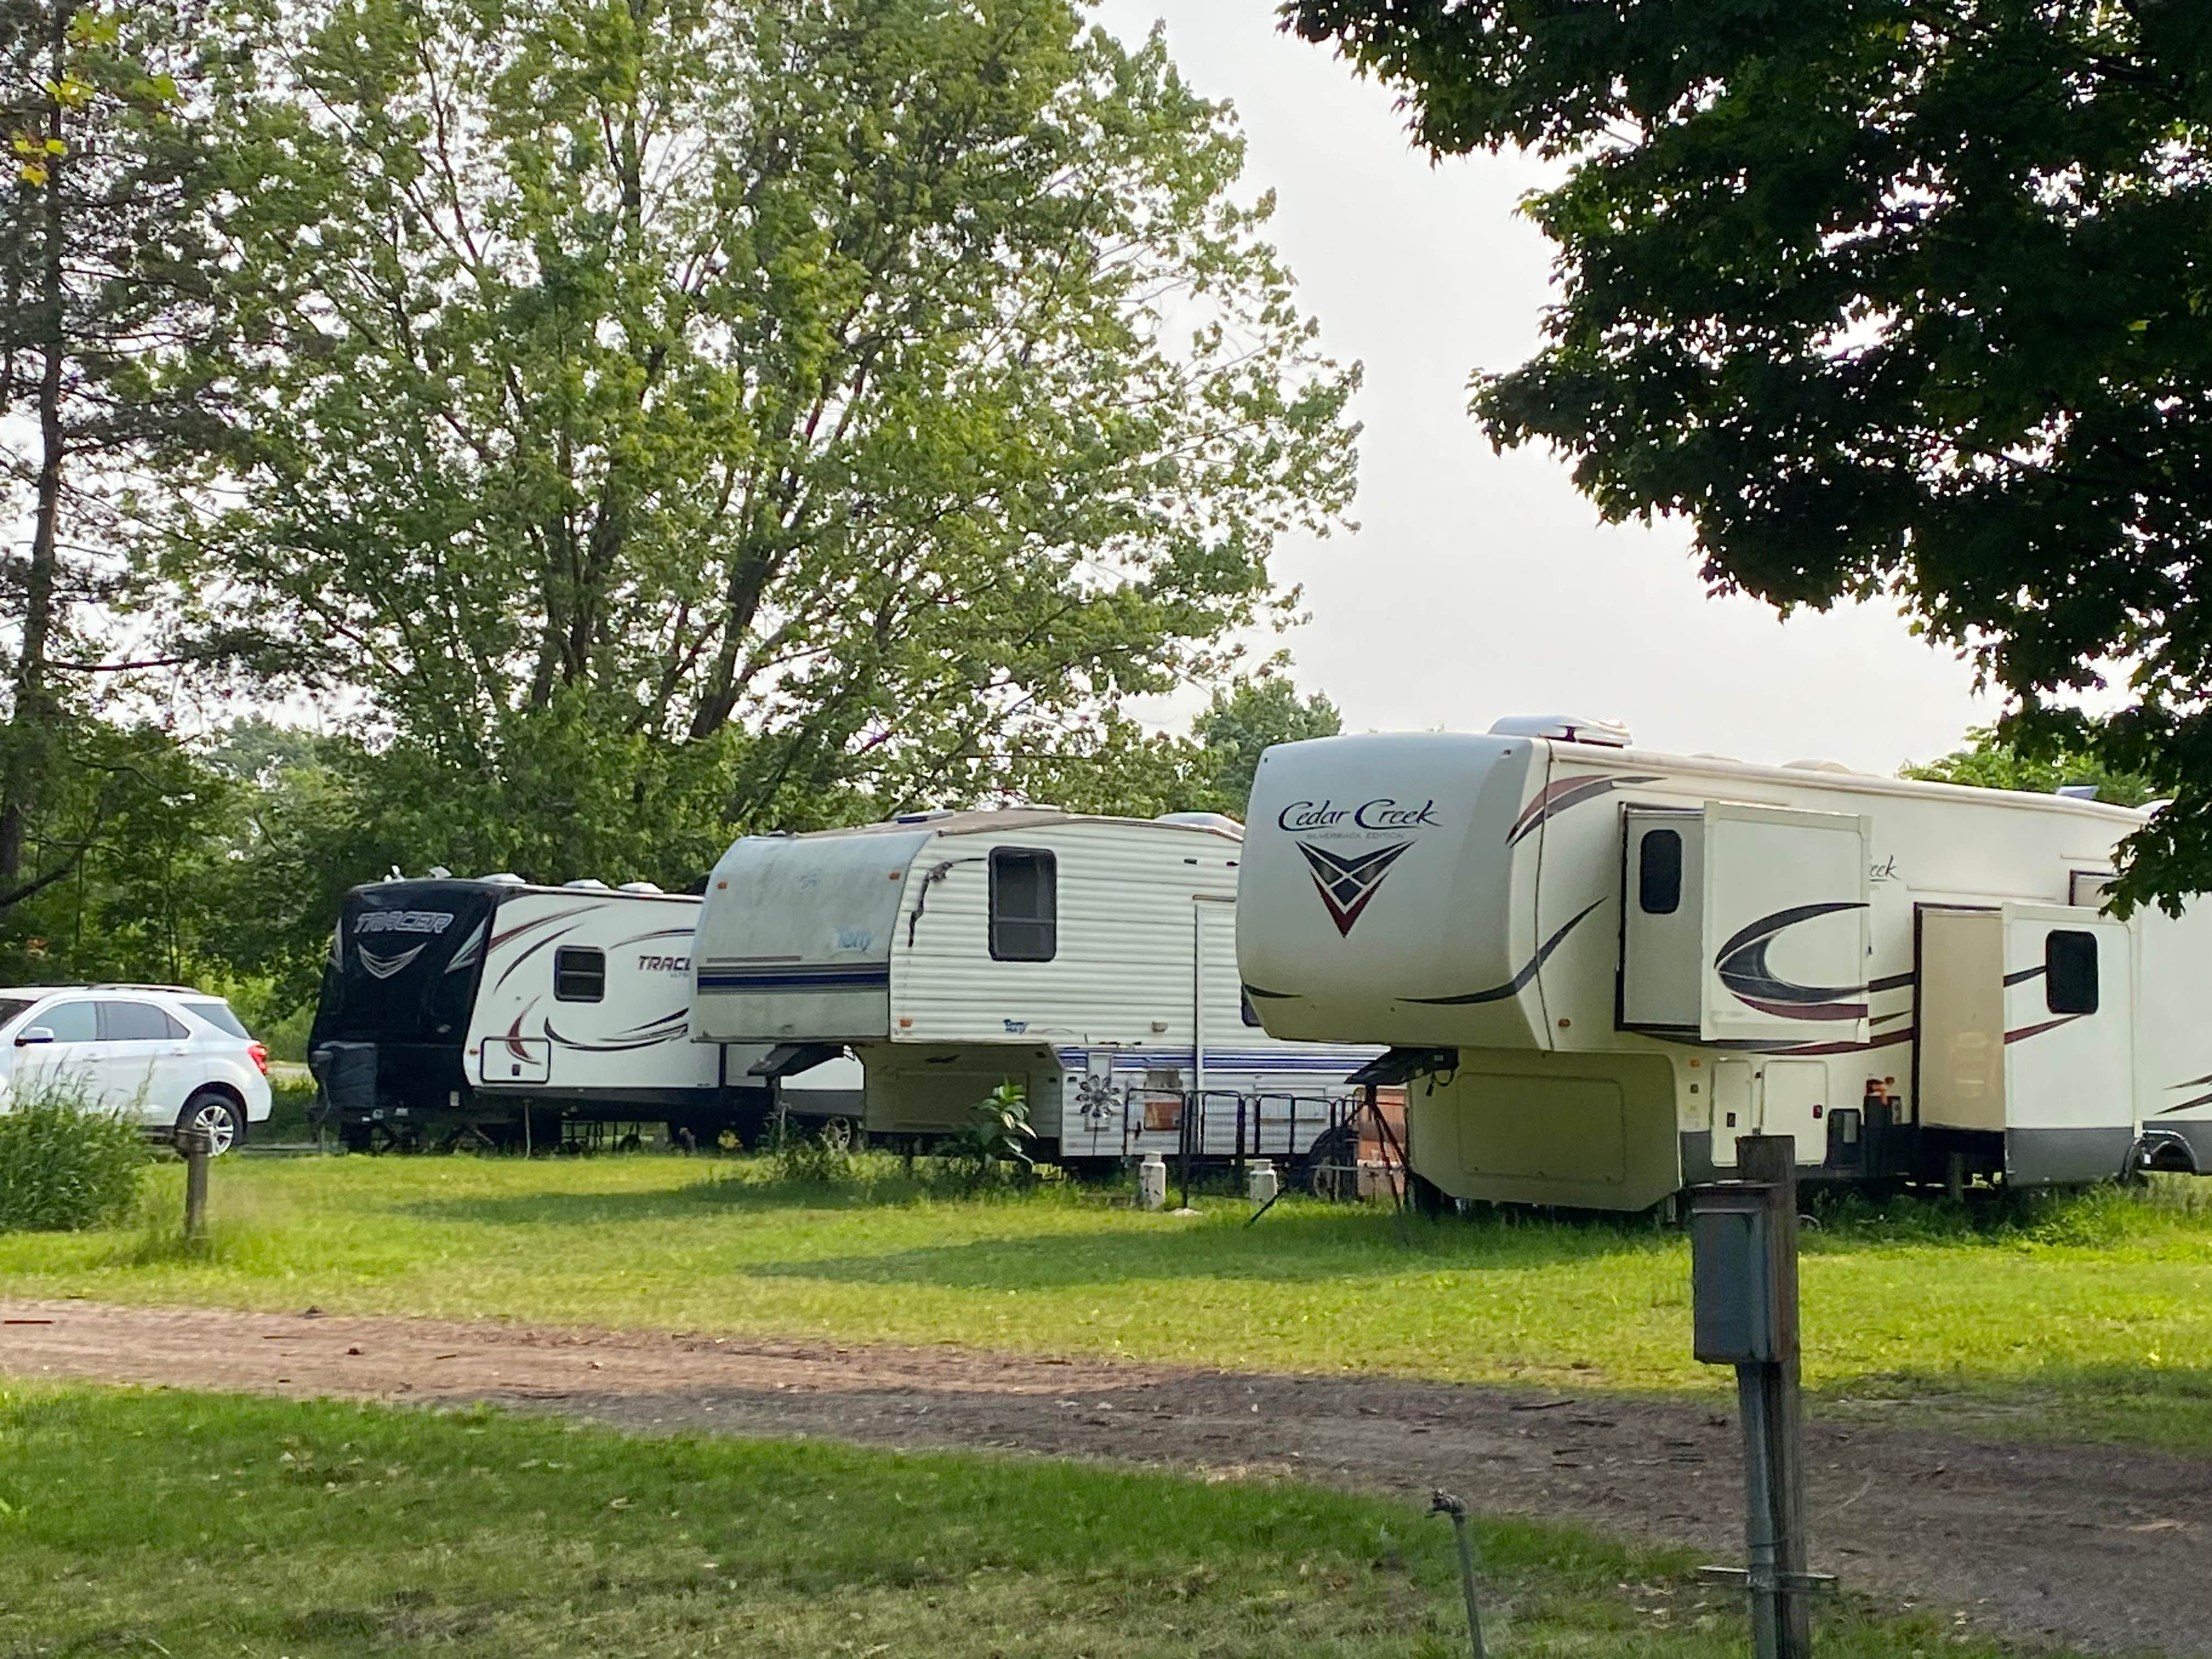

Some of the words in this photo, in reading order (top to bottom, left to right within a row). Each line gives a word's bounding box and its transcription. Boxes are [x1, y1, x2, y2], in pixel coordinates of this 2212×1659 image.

[1279, 800, 1351, 831] Cedar
[1355, 799, 1444, 830] Creek
[1870, 855, 1901, 882] eek
[354, 910, 454, 933] TRACER
